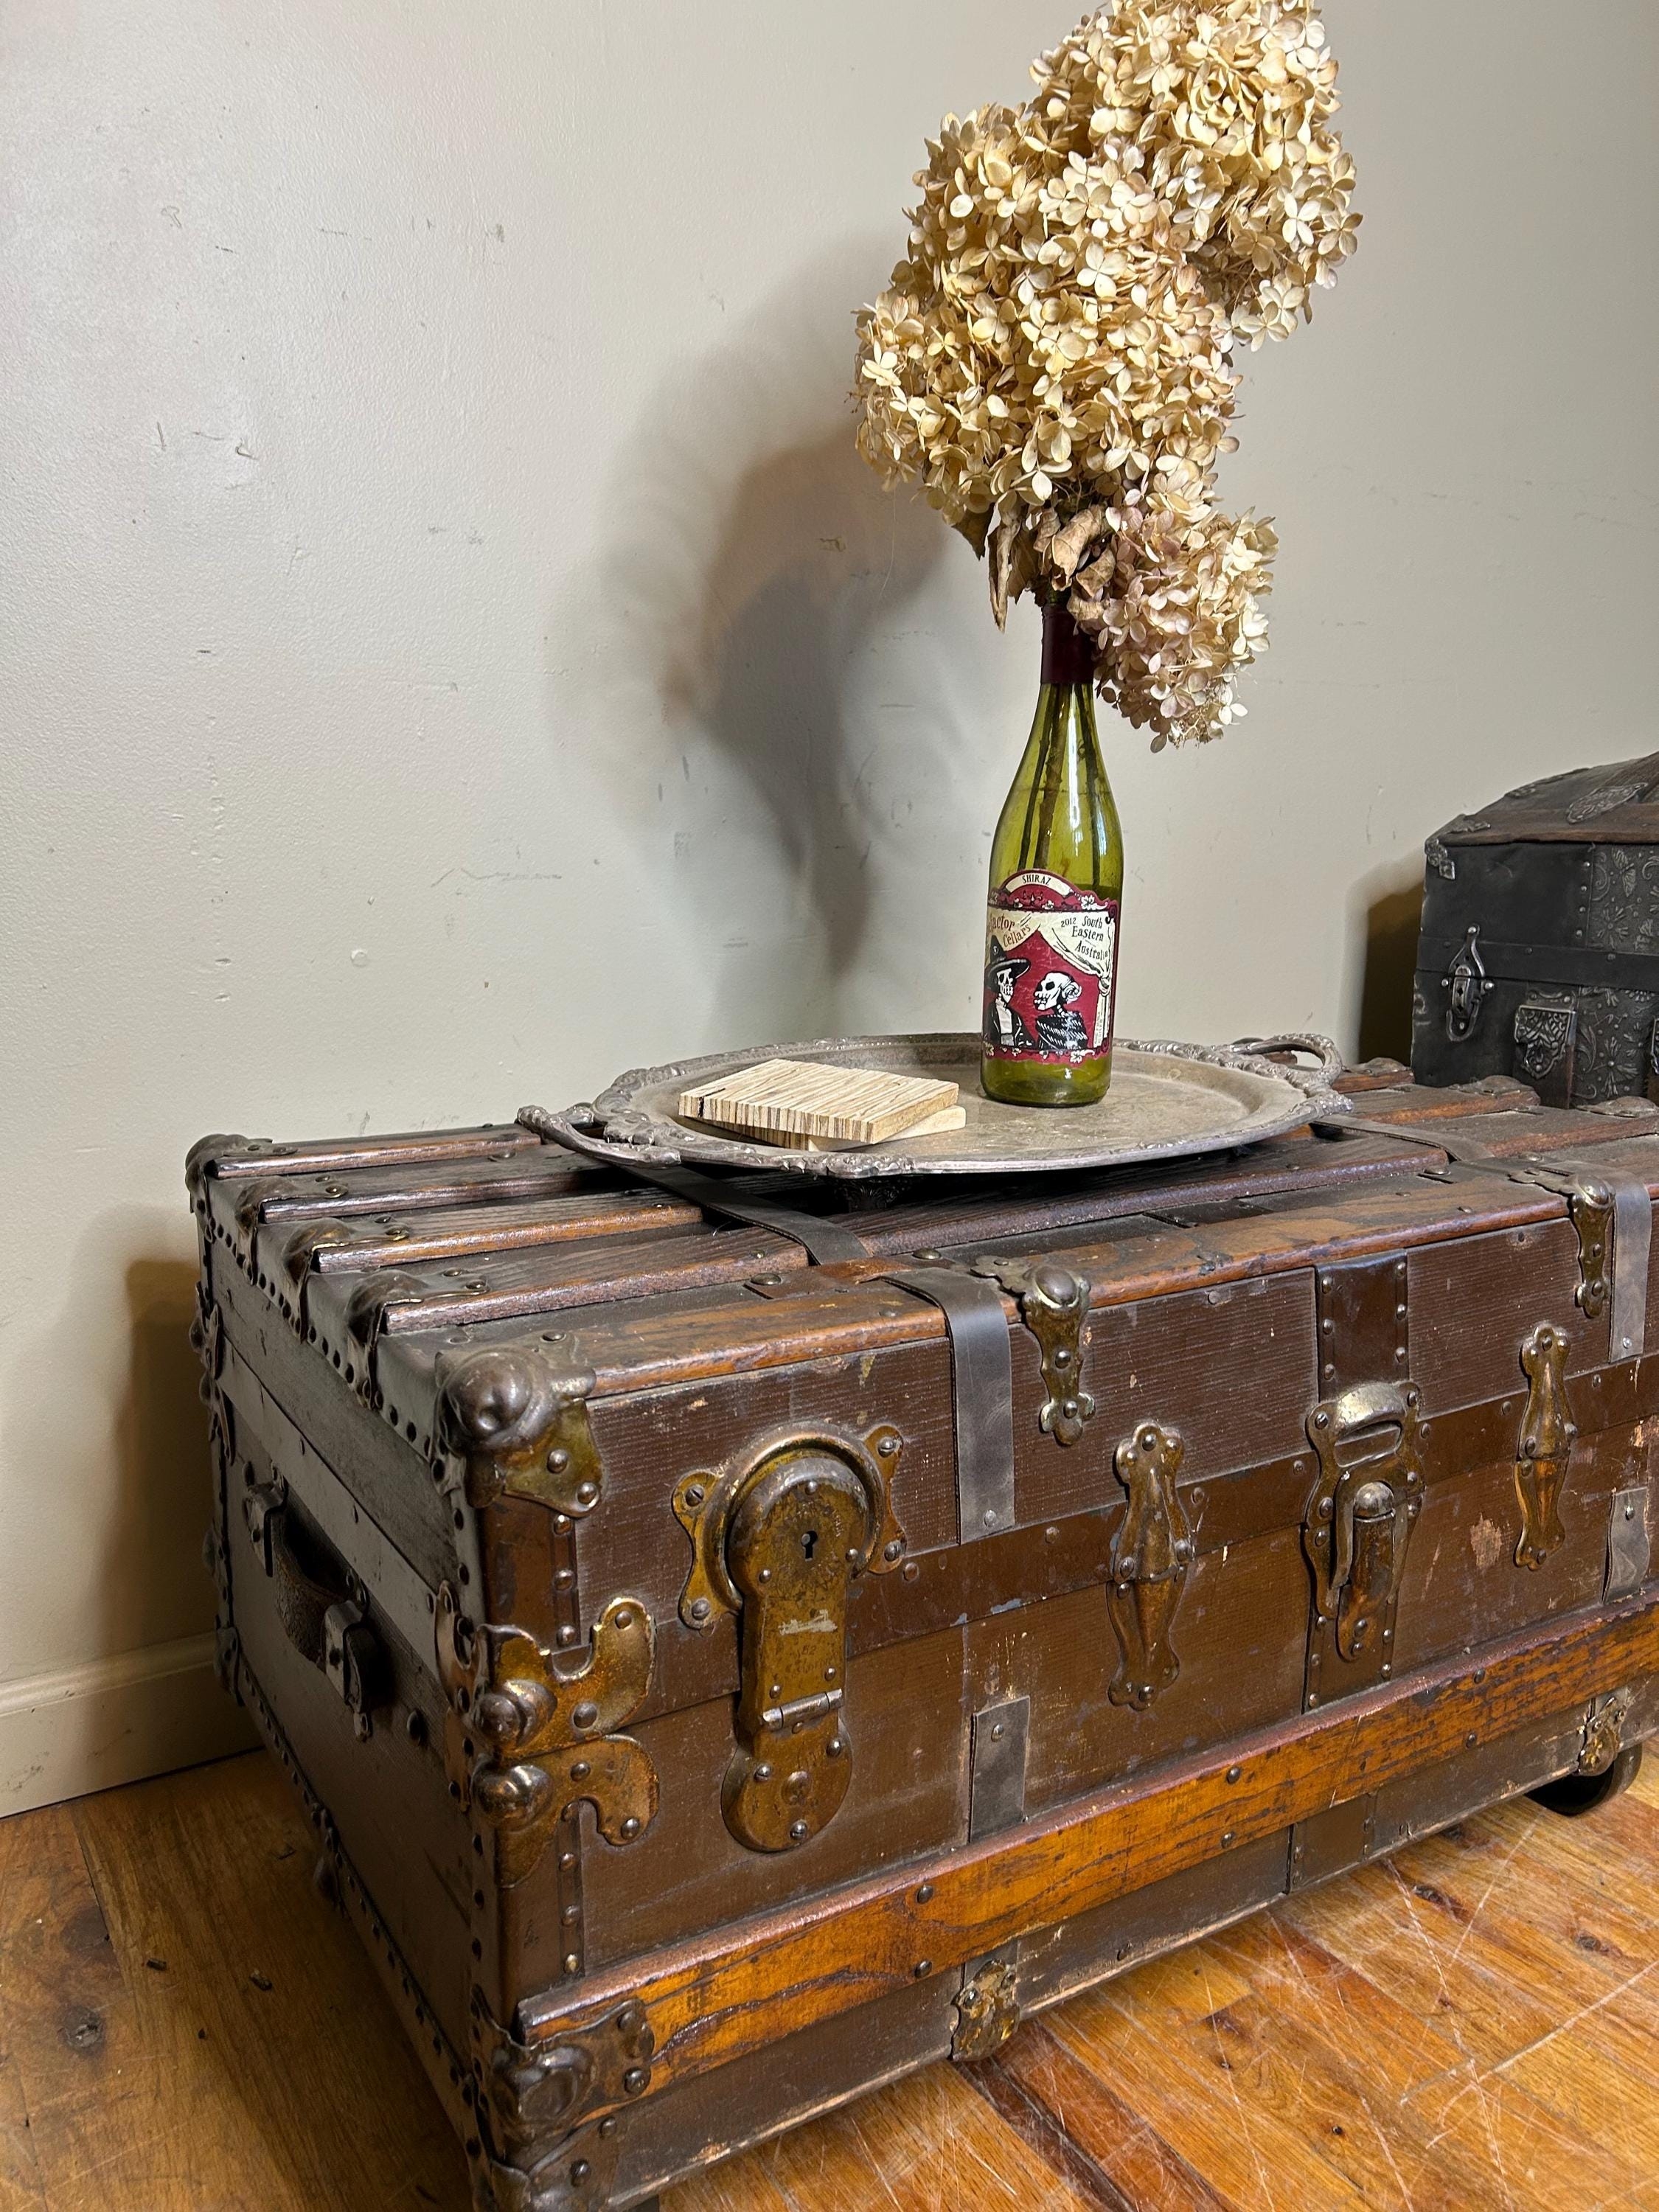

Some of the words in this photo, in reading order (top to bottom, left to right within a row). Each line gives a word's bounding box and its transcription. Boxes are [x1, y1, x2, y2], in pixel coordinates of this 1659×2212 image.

[1022, 874, 1051, 885] SHIRAZ
[1060, 917, 1077, 928] 2012
[1082, 915, 1103, 929] South
[1003, 924, 1031, 947] Cellars
[1071, 925, 1104, 942] Eastern
[1074, 940, 1108, 960] Australia
